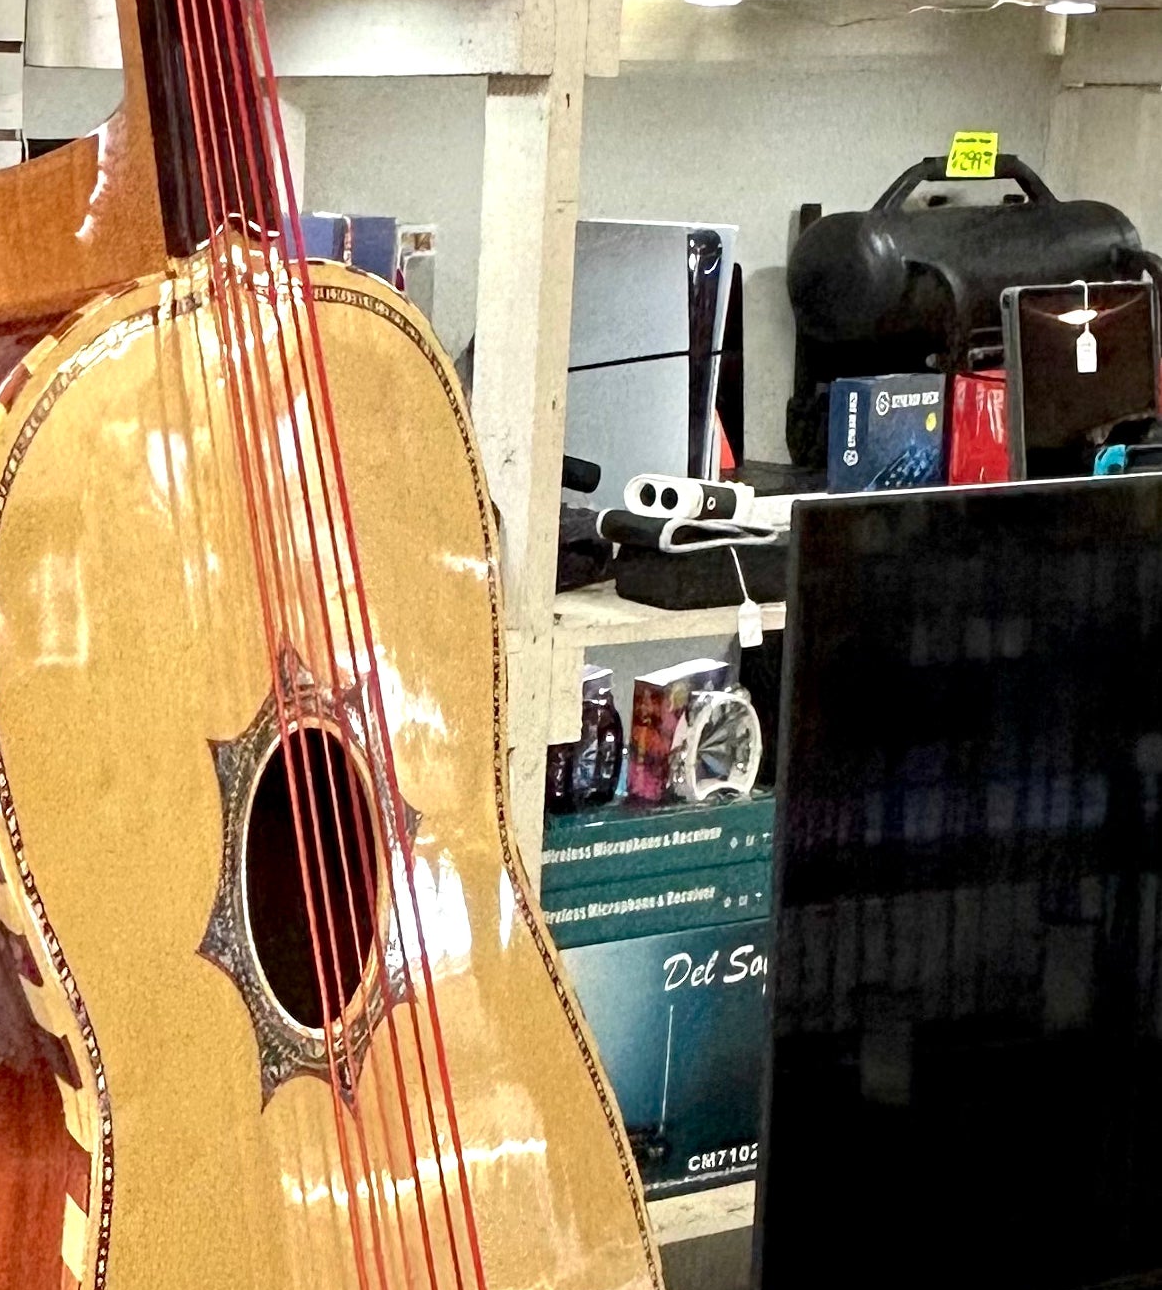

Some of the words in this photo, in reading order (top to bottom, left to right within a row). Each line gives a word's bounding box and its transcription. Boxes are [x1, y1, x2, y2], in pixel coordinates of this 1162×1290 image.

[593, 835, 663, 858] Microphone
[672, 826, 722, 845] Receiver
[587, 895, 656, 918] Microphone
[667, 886, 716, 906] Receiver
[663, 949, 720, 992] Del
